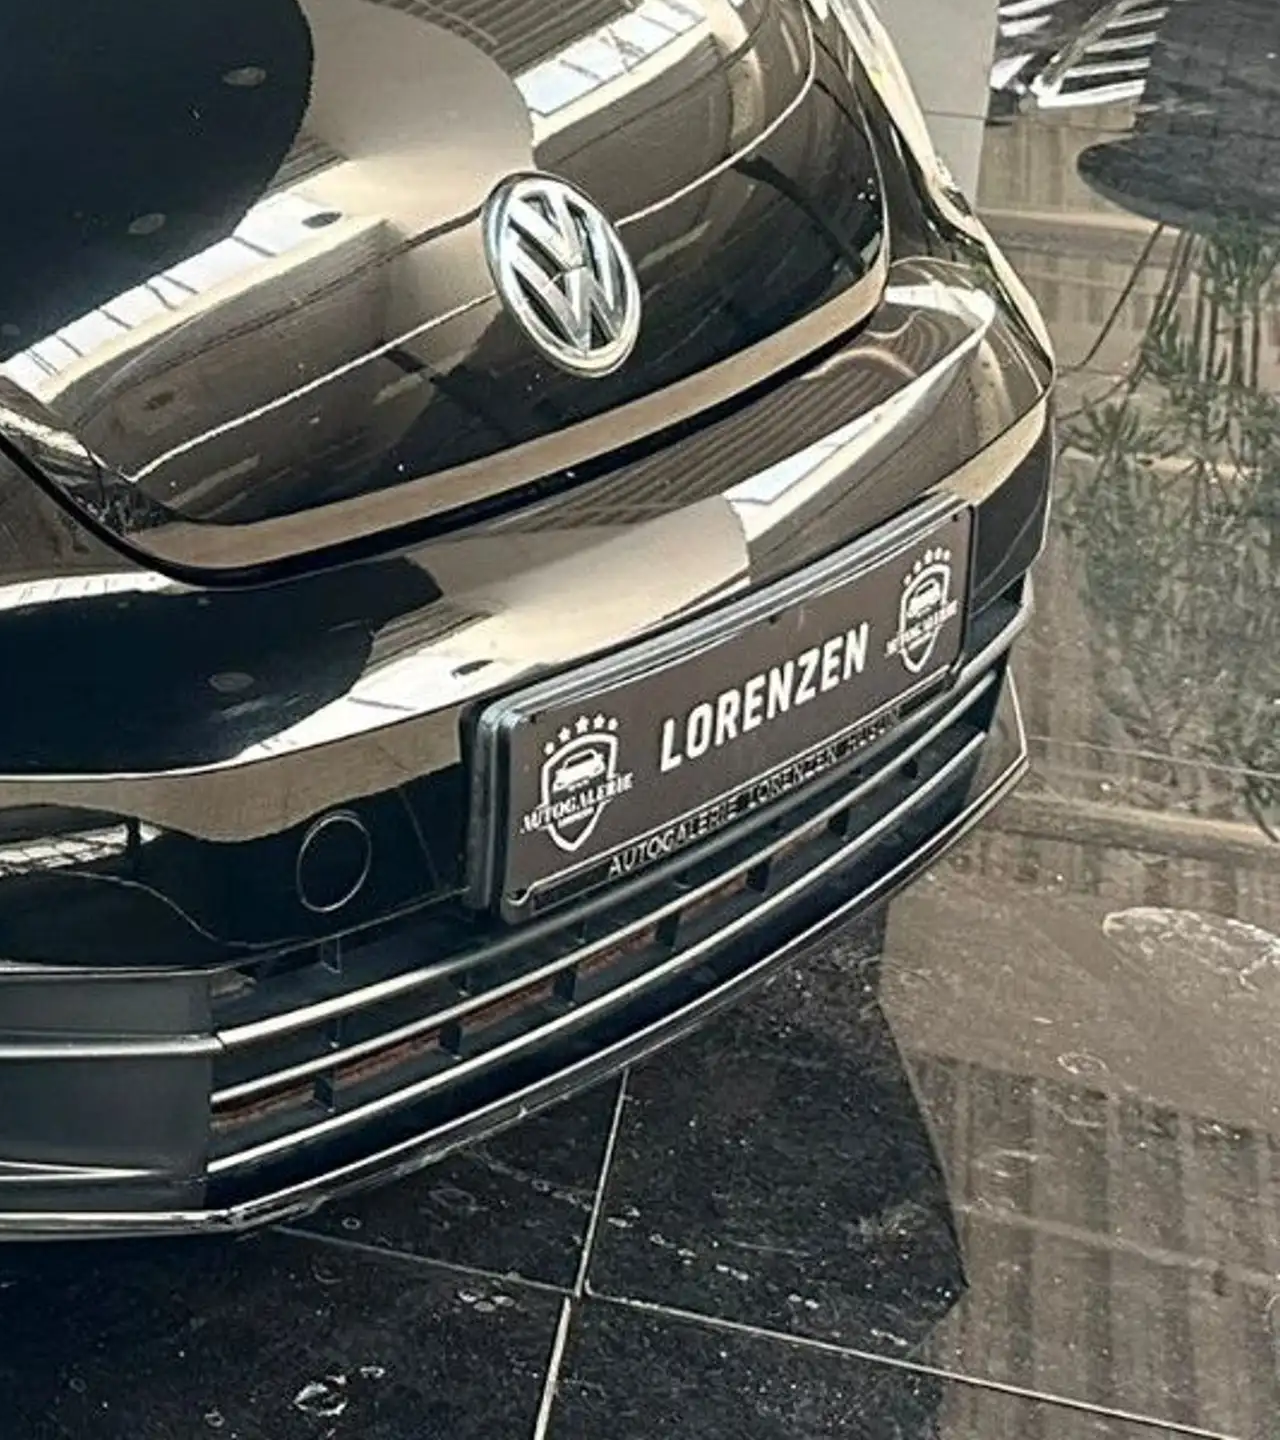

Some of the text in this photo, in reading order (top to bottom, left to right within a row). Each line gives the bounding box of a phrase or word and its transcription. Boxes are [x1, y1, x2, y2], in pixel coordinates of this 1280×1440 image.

[659, 620, 871, 772] LORENZEN
[519, 771, 634, 836] AUTOGALERIE
[607, 798, 739, 880] AUTOGALERIE
